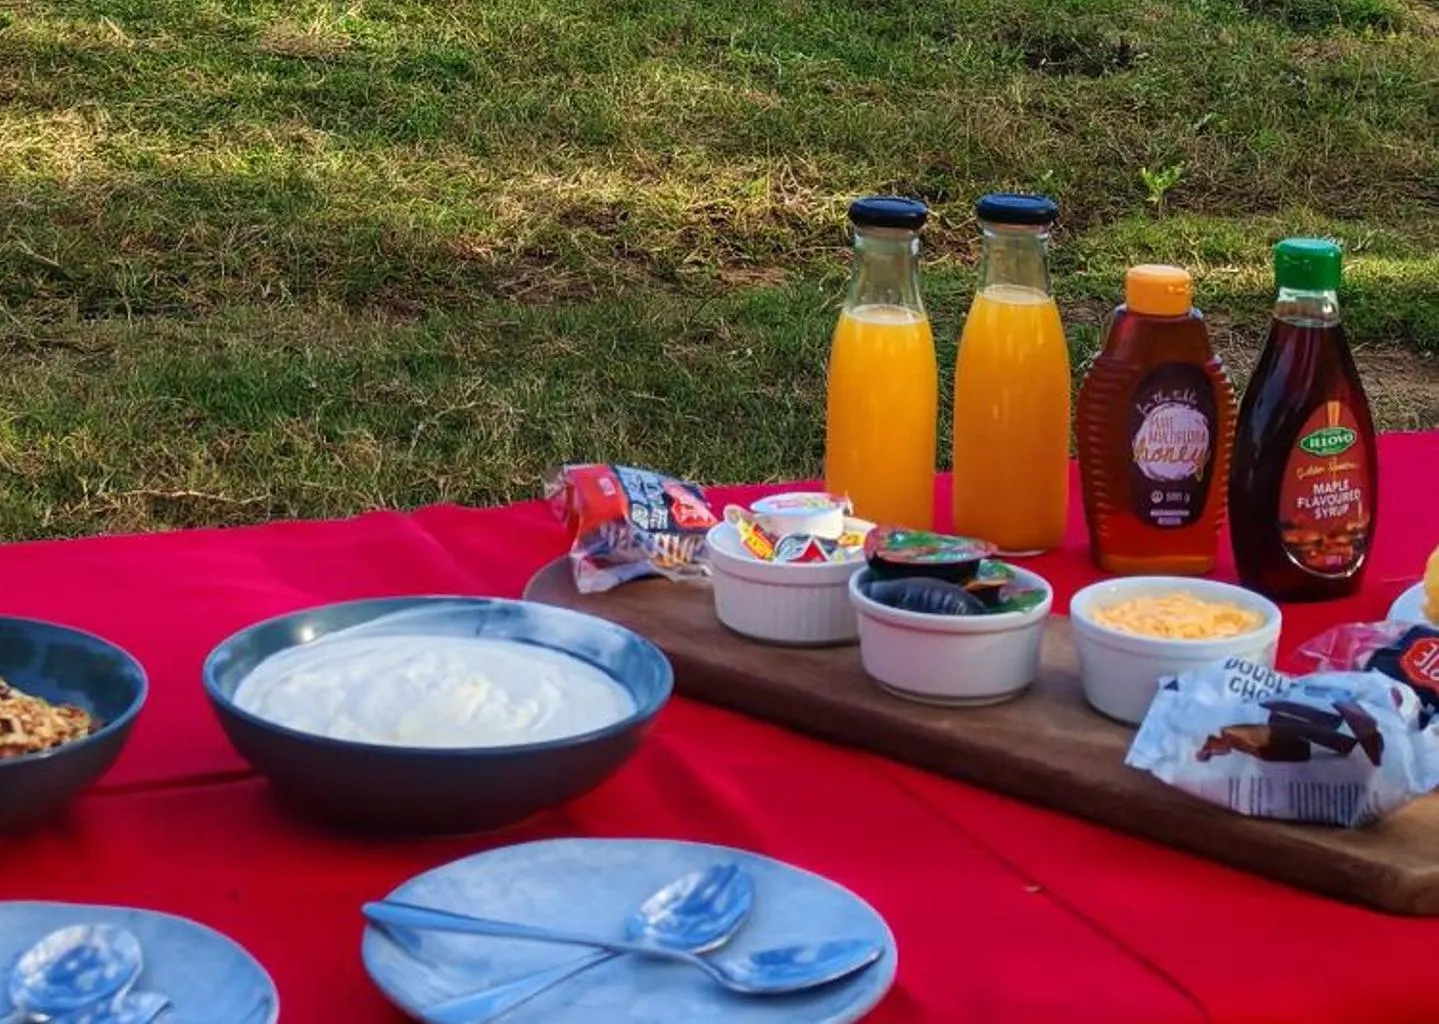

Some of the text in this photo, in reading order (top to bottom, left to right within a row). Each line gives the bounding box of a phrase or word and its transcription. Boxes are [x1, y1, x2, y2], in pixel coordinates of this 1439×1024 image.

[1133, 437, 1206, 481] honey
[1313, 479, 1350, 494] MAPLE
[1296, 488, 1361, 509] FLAVOURED
[1315, 503, 1350, 520] SYRUP
